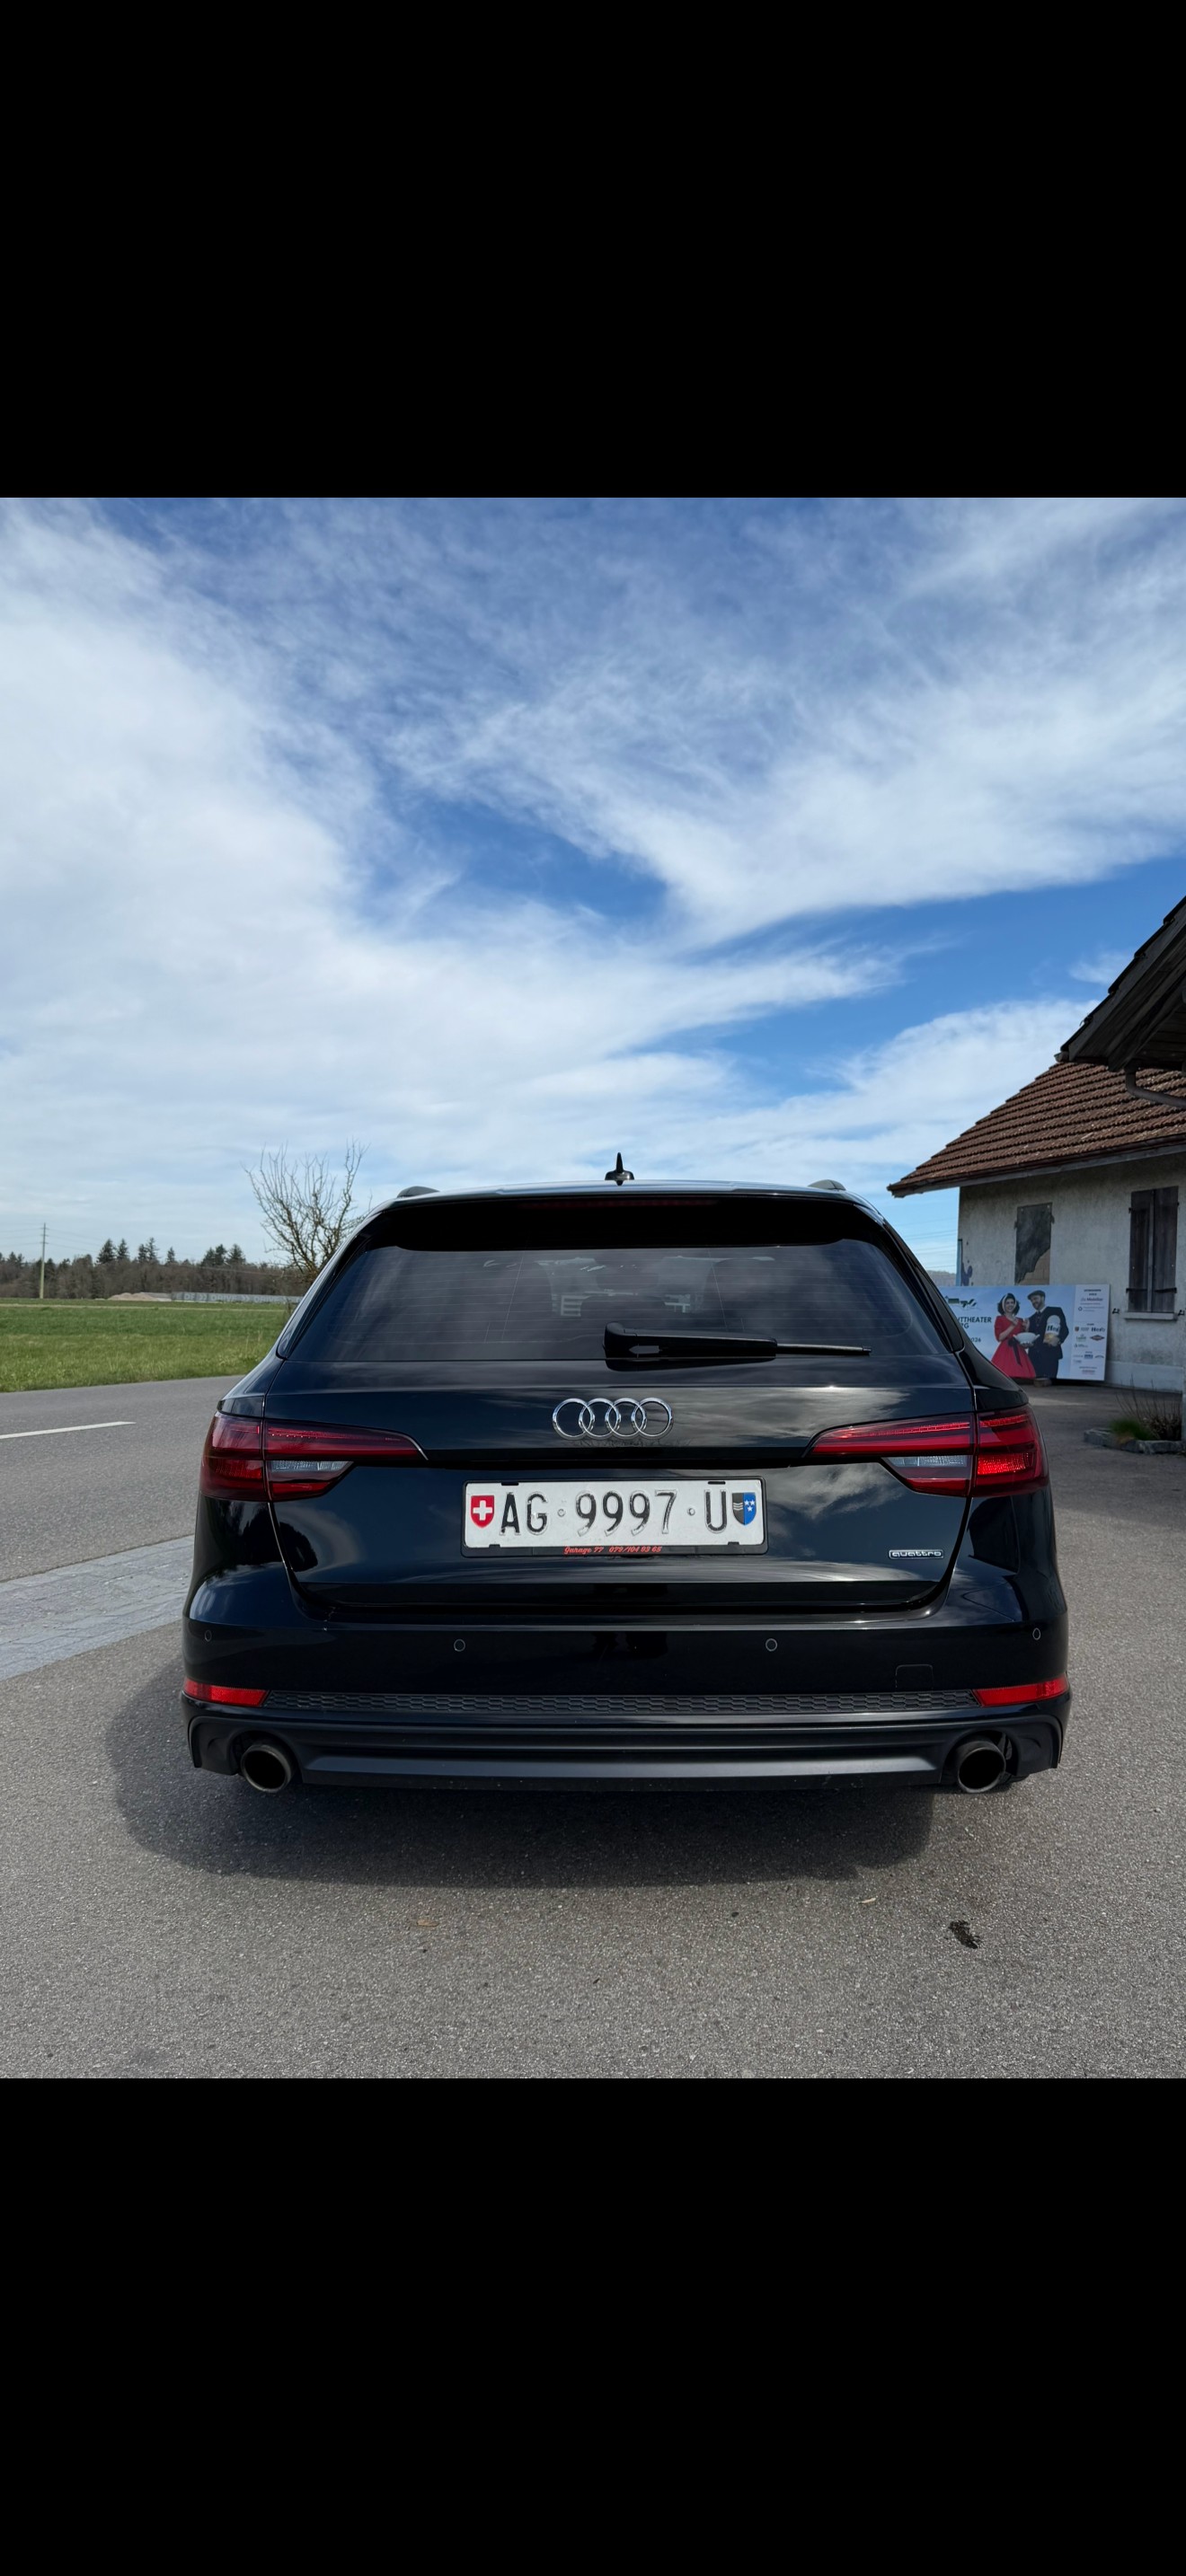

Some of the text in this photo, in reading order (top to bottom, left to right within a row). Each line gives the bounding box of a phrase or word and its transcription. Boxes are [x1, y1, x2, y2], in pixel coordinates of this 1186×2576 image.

[499, 1488, 729, 1537] AG 9997 U
[563, 1545, 592, 1556] Garage
[891, 1549, 943, 1558] quattro
